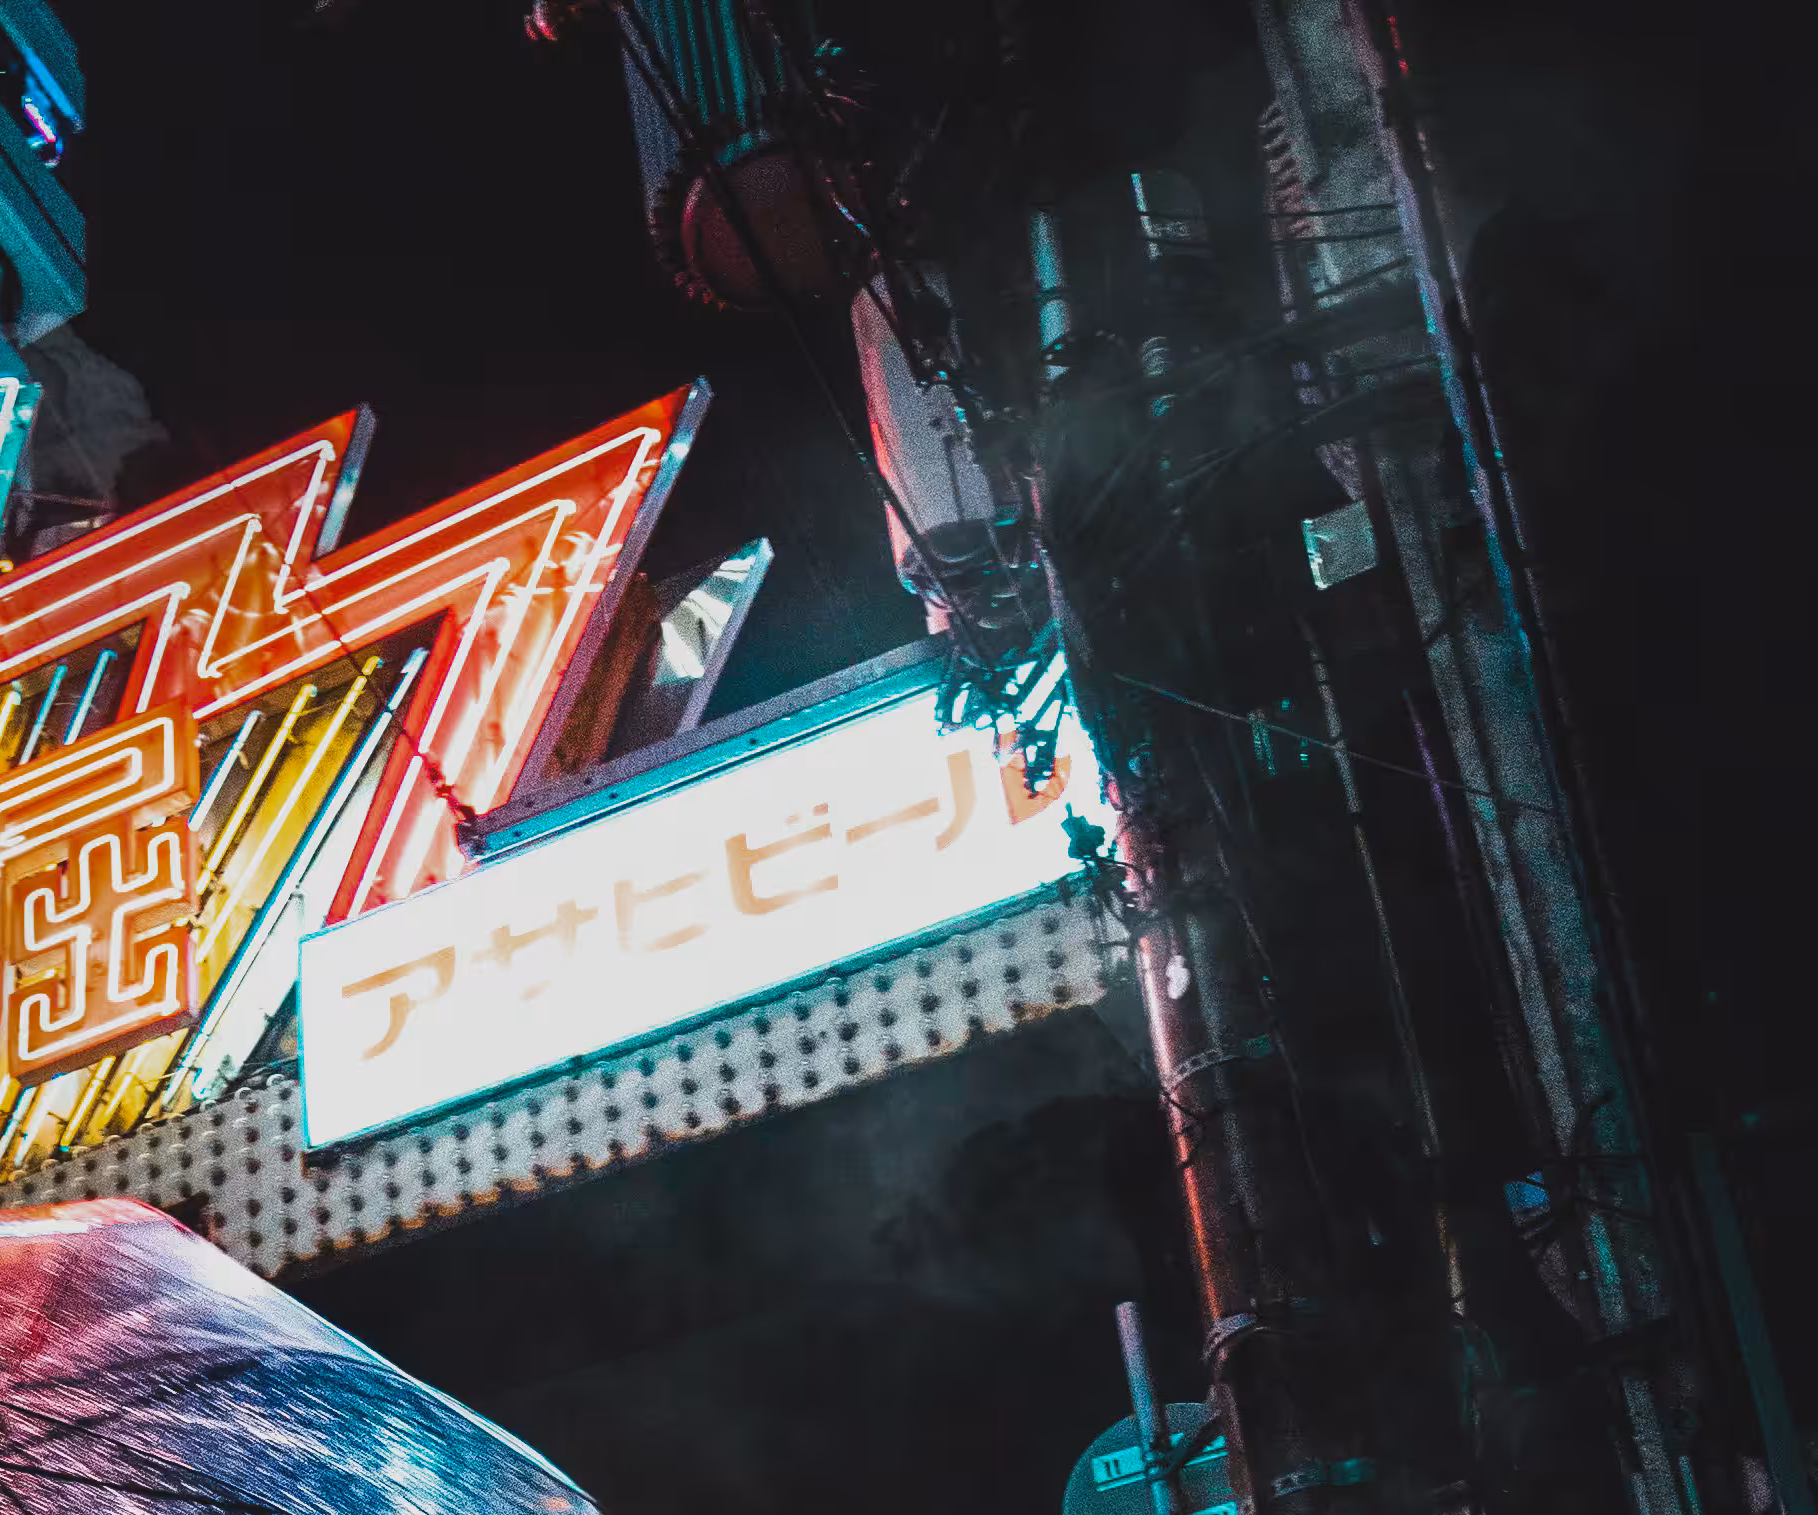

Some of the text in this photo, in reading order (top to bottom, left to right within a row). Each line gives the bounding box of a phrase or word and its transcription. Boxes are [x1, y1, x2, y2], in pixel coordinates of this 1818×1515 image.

[341, 749, 978, 1063] アサヒビール
